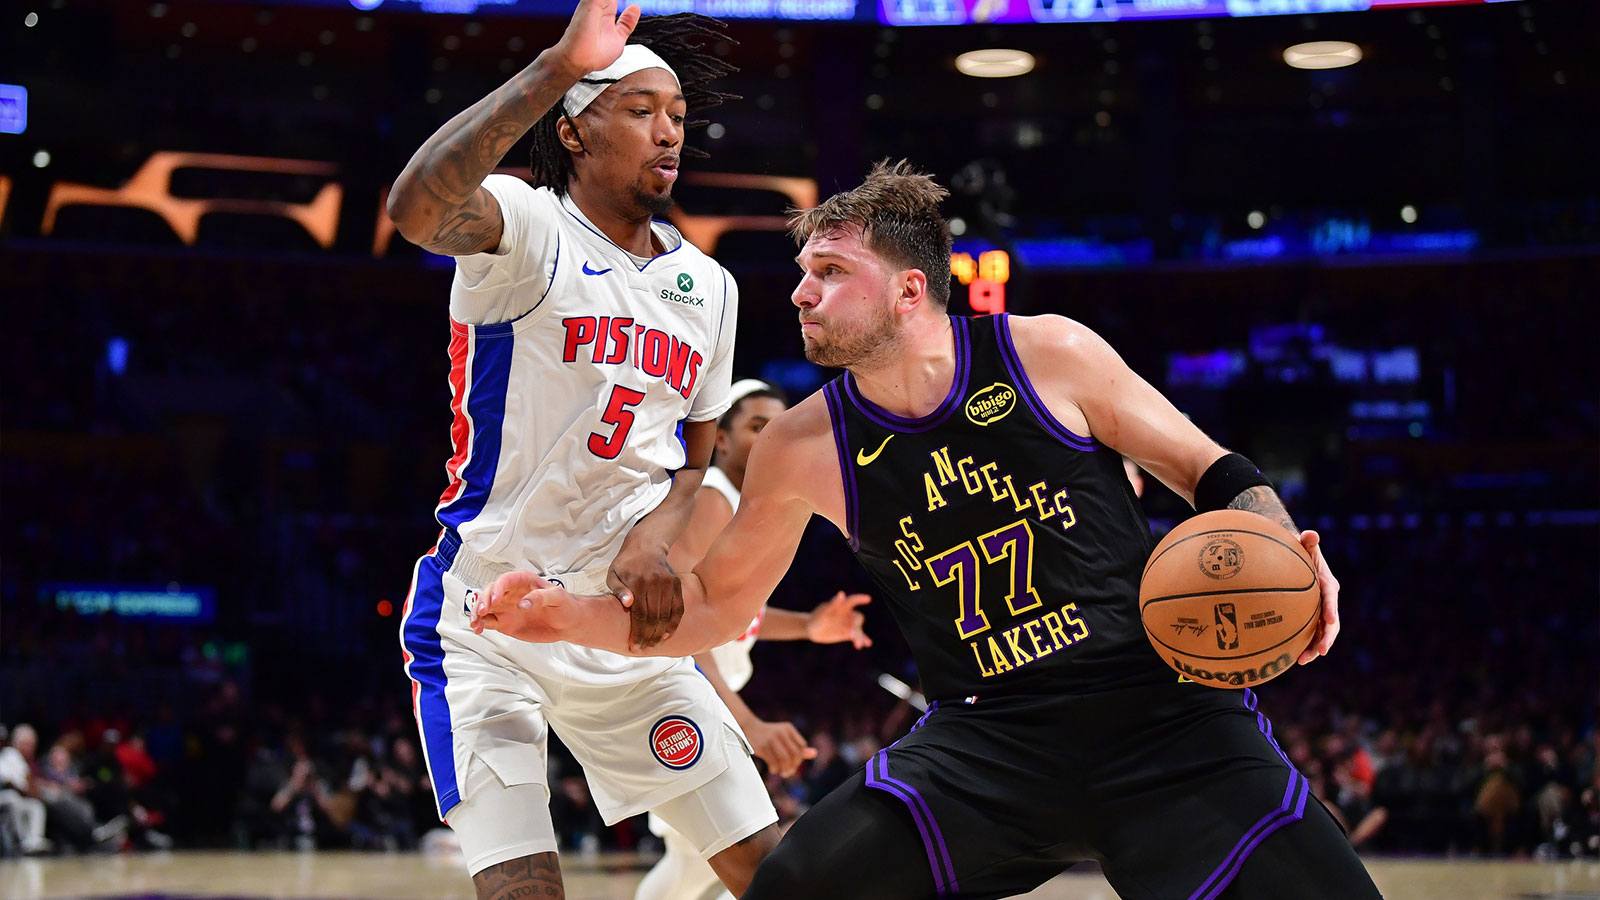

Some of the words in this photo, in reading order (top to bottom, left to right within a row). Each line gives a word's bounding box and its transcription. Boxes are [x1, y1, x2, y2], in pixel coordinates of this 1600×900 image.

[660, 289, 704, 307] StockX
[562, 316, 703, 400] PISTONS
[587, 384, 645, 460] 5
[969, 390, 1012, 416] bibigo
[892, 515, 924, 591] LOS
[922, 446, 1078, 531] ANGELES
[924, 518, 1043, 640] 77
[970, 602, 1090, 678] LAKERS
[658, 728, 689, 750] DETROIT
[662, 736, 694, 758] PISTONS
